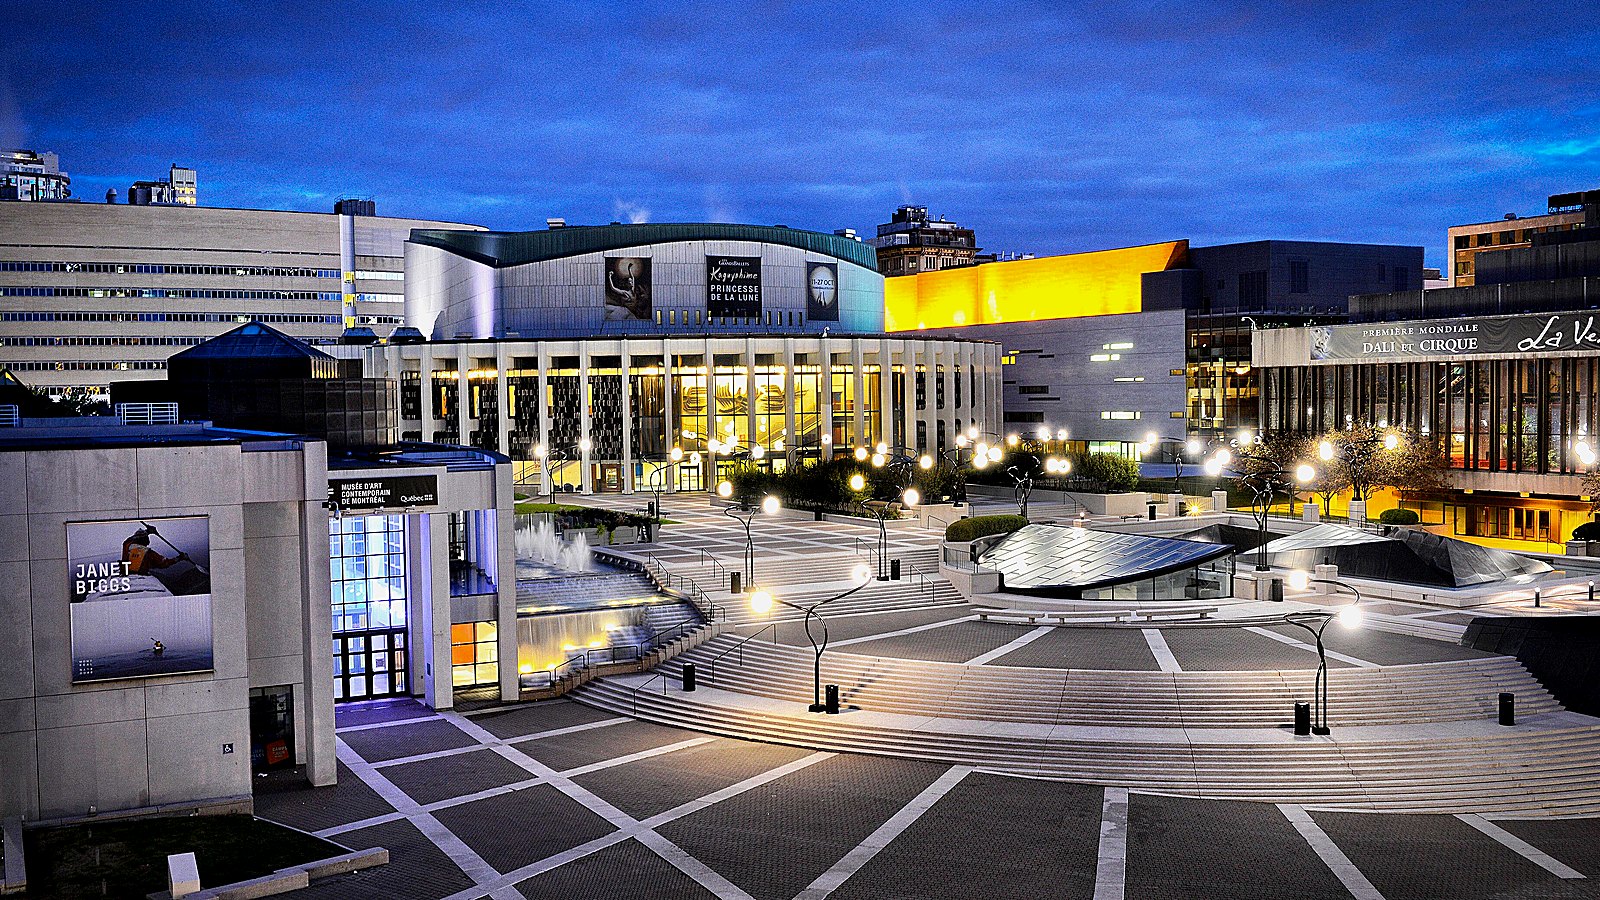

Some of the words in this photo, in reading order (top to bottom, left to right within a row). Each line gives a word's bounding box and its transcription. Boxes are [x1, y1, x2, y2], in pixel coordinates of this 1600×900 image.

[710, 284, 759, 292] PRINCESSE
[711, 293, 721, 301] DE
[724, 293, 735, 301] LA
[738, 293, 759, 301] LUNE
[1362, 326, 1414, 337] PREMIÈRE
[1419, 324, 1479, 335] MONDIALE
[1517, 315, 1563, 351] La
[1362, 341, 1395, 354] DALI
[1401, 343, 1414, 352] ET
[1420, 337, 1478, 353] CIRQUE
[341, 482, 363, 491] MUSÉE
[364, 482, 383, 490] D'ART
[341, 489, 391, 498] CONTEMPORAIN
[351, 496, 386, 505] MONTRÉAL
[400, 494, 424, 503] Québec
[76, 561, 132, 578] JANET
[76, 577, 131, 594] BIGGS
